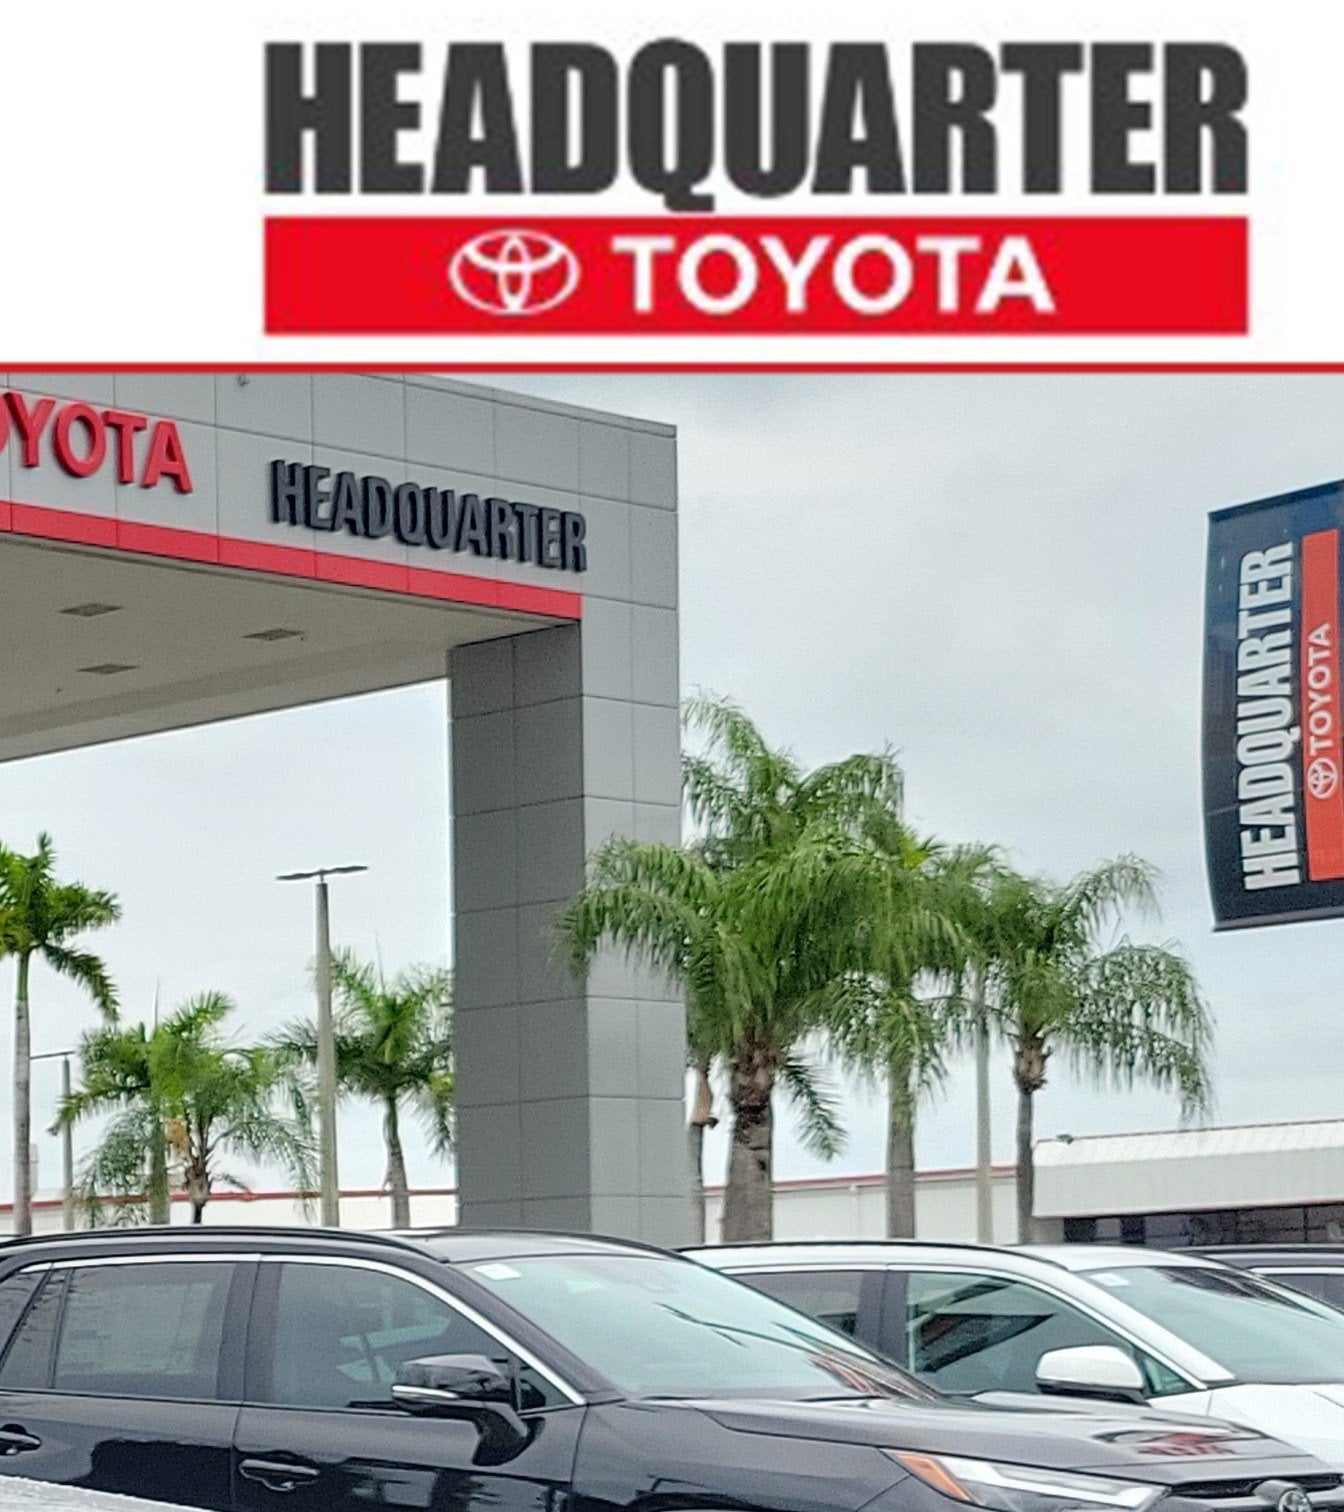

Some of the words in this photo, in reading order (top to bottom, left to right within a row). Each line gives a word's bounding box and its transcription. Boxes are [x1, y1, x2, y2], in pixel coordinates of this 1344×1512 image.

[269, 459, 587, 572] HEADQUARTER
[1237, 541, 1301, 890] HEADQUARTER
[1307, 622, 1333, 757] TOYOTA
